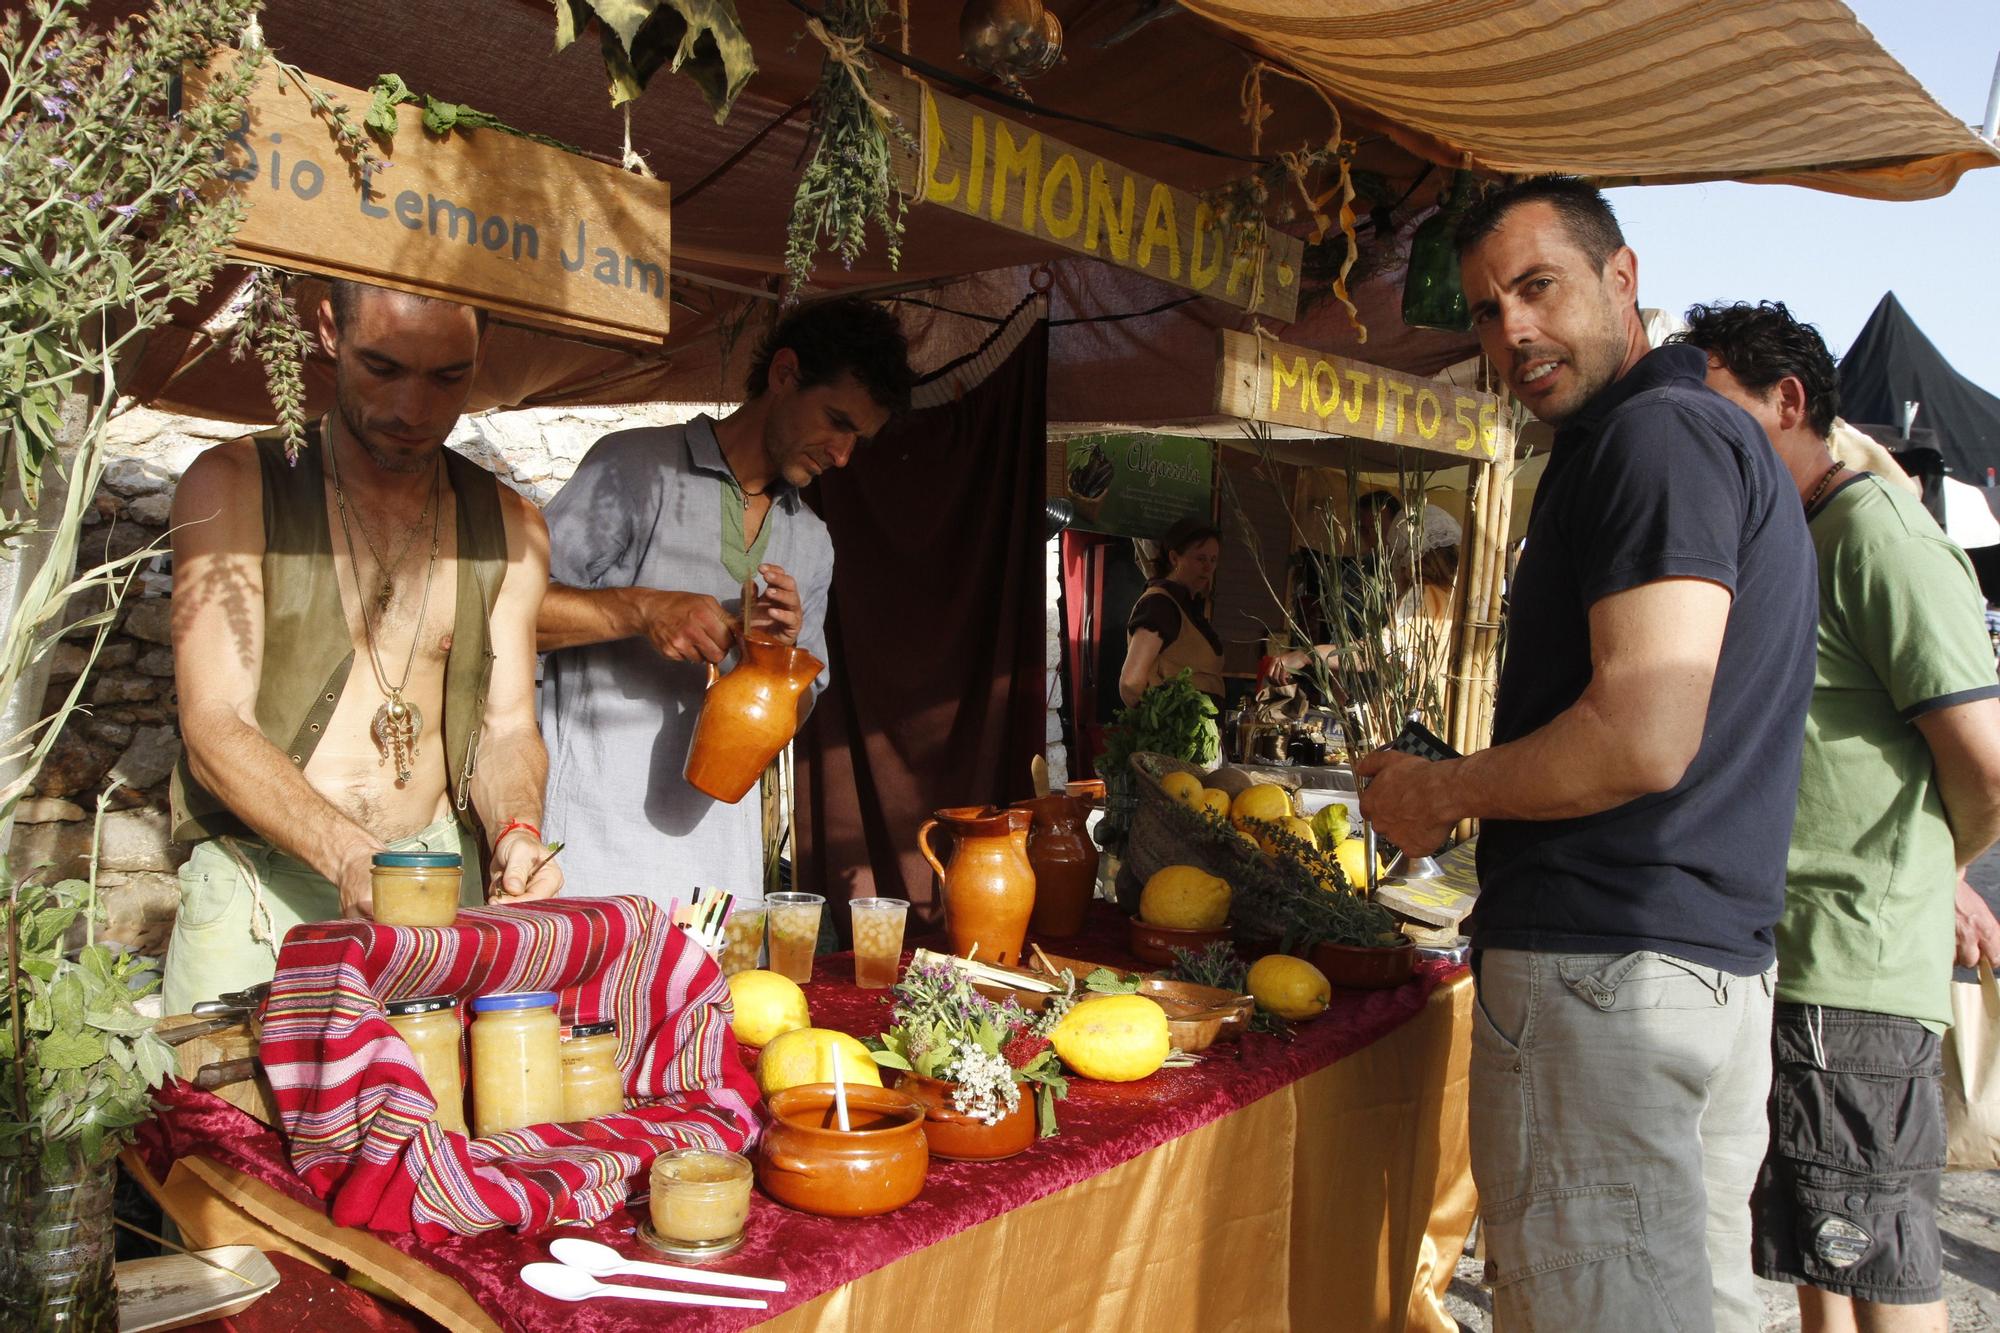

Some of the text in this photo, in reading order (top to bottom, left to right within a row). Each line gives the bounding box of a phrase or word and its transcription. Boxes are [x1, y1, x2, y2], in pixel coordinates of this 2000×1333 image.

[210, 110, 665, 299] Bio Lemon Jam
[1271, 352, 1442, 440] MOJITO
